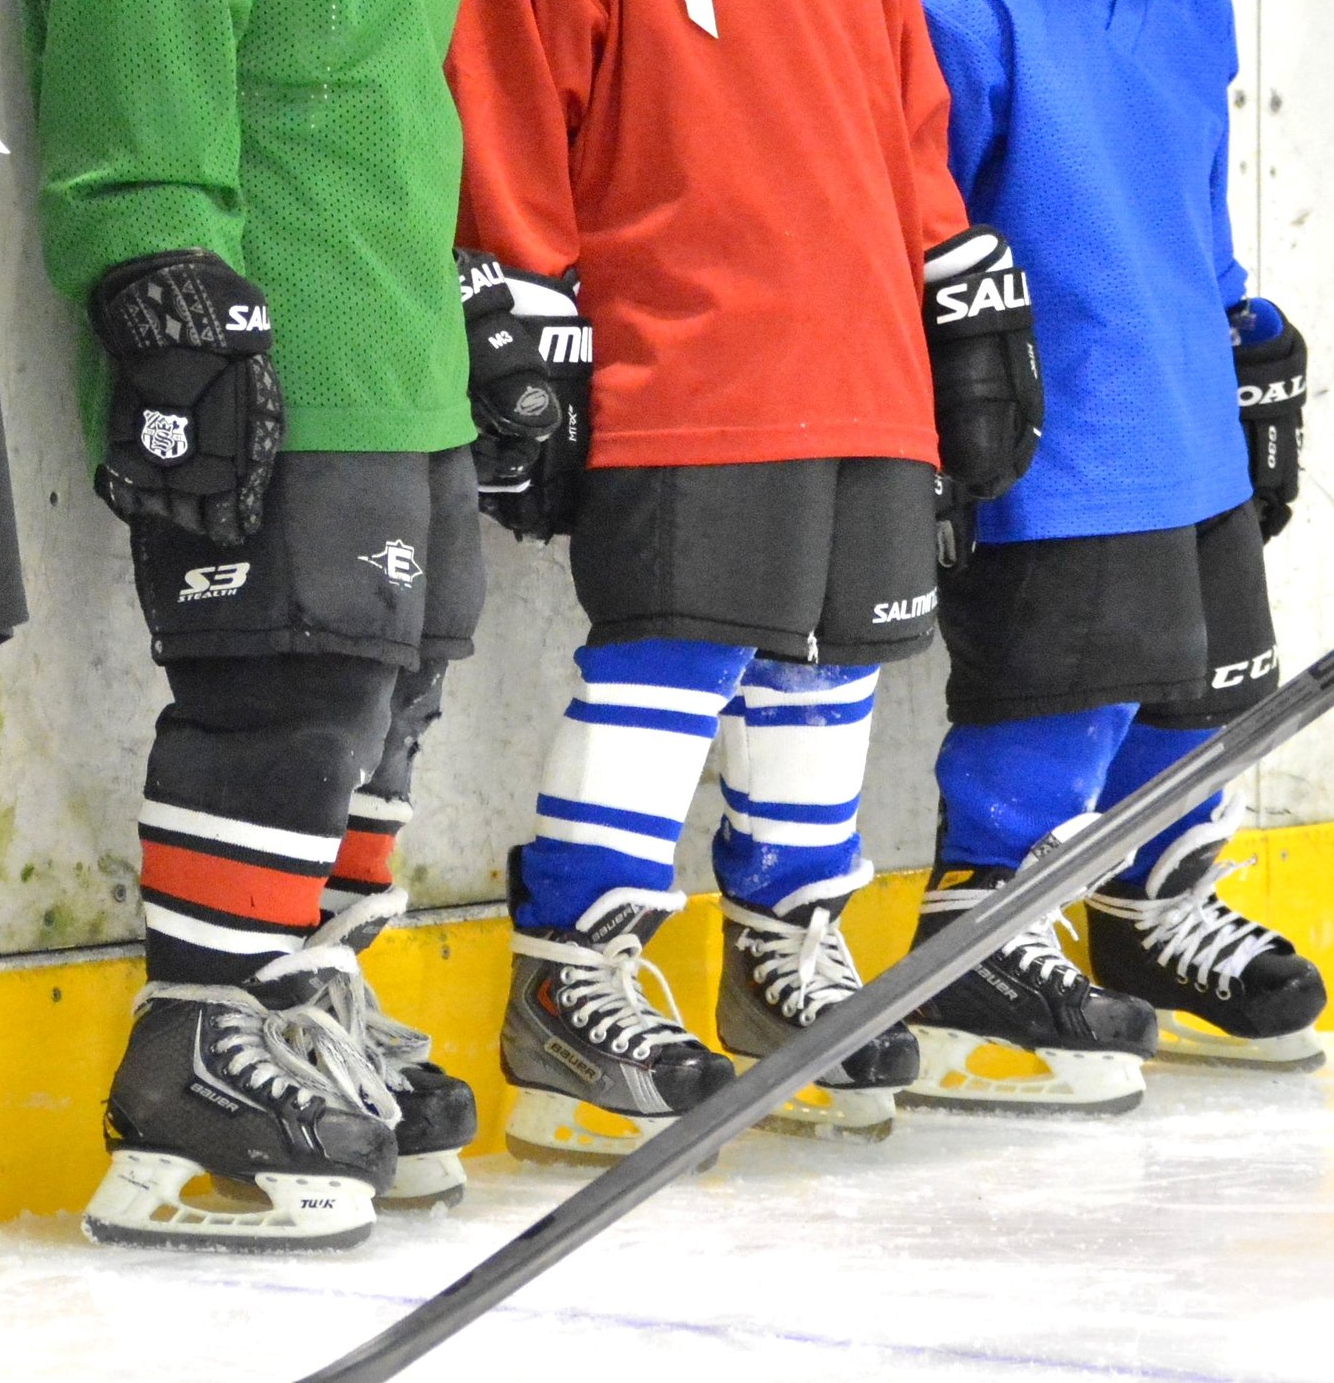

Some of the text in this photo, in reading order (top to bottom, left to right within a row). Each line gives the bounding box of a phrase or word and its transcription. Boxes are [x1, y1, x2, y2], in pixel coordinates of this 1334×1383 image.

[488, 331, 513, 349] M3
[180, 562, 250, 596] S3
[177, 589, 237, 603] STEALTH
[591, 904, 635, 943] BAUER
[550, 1043, 596, 1081] BAUER
[190, 1083, 240, 1112] BAUER
